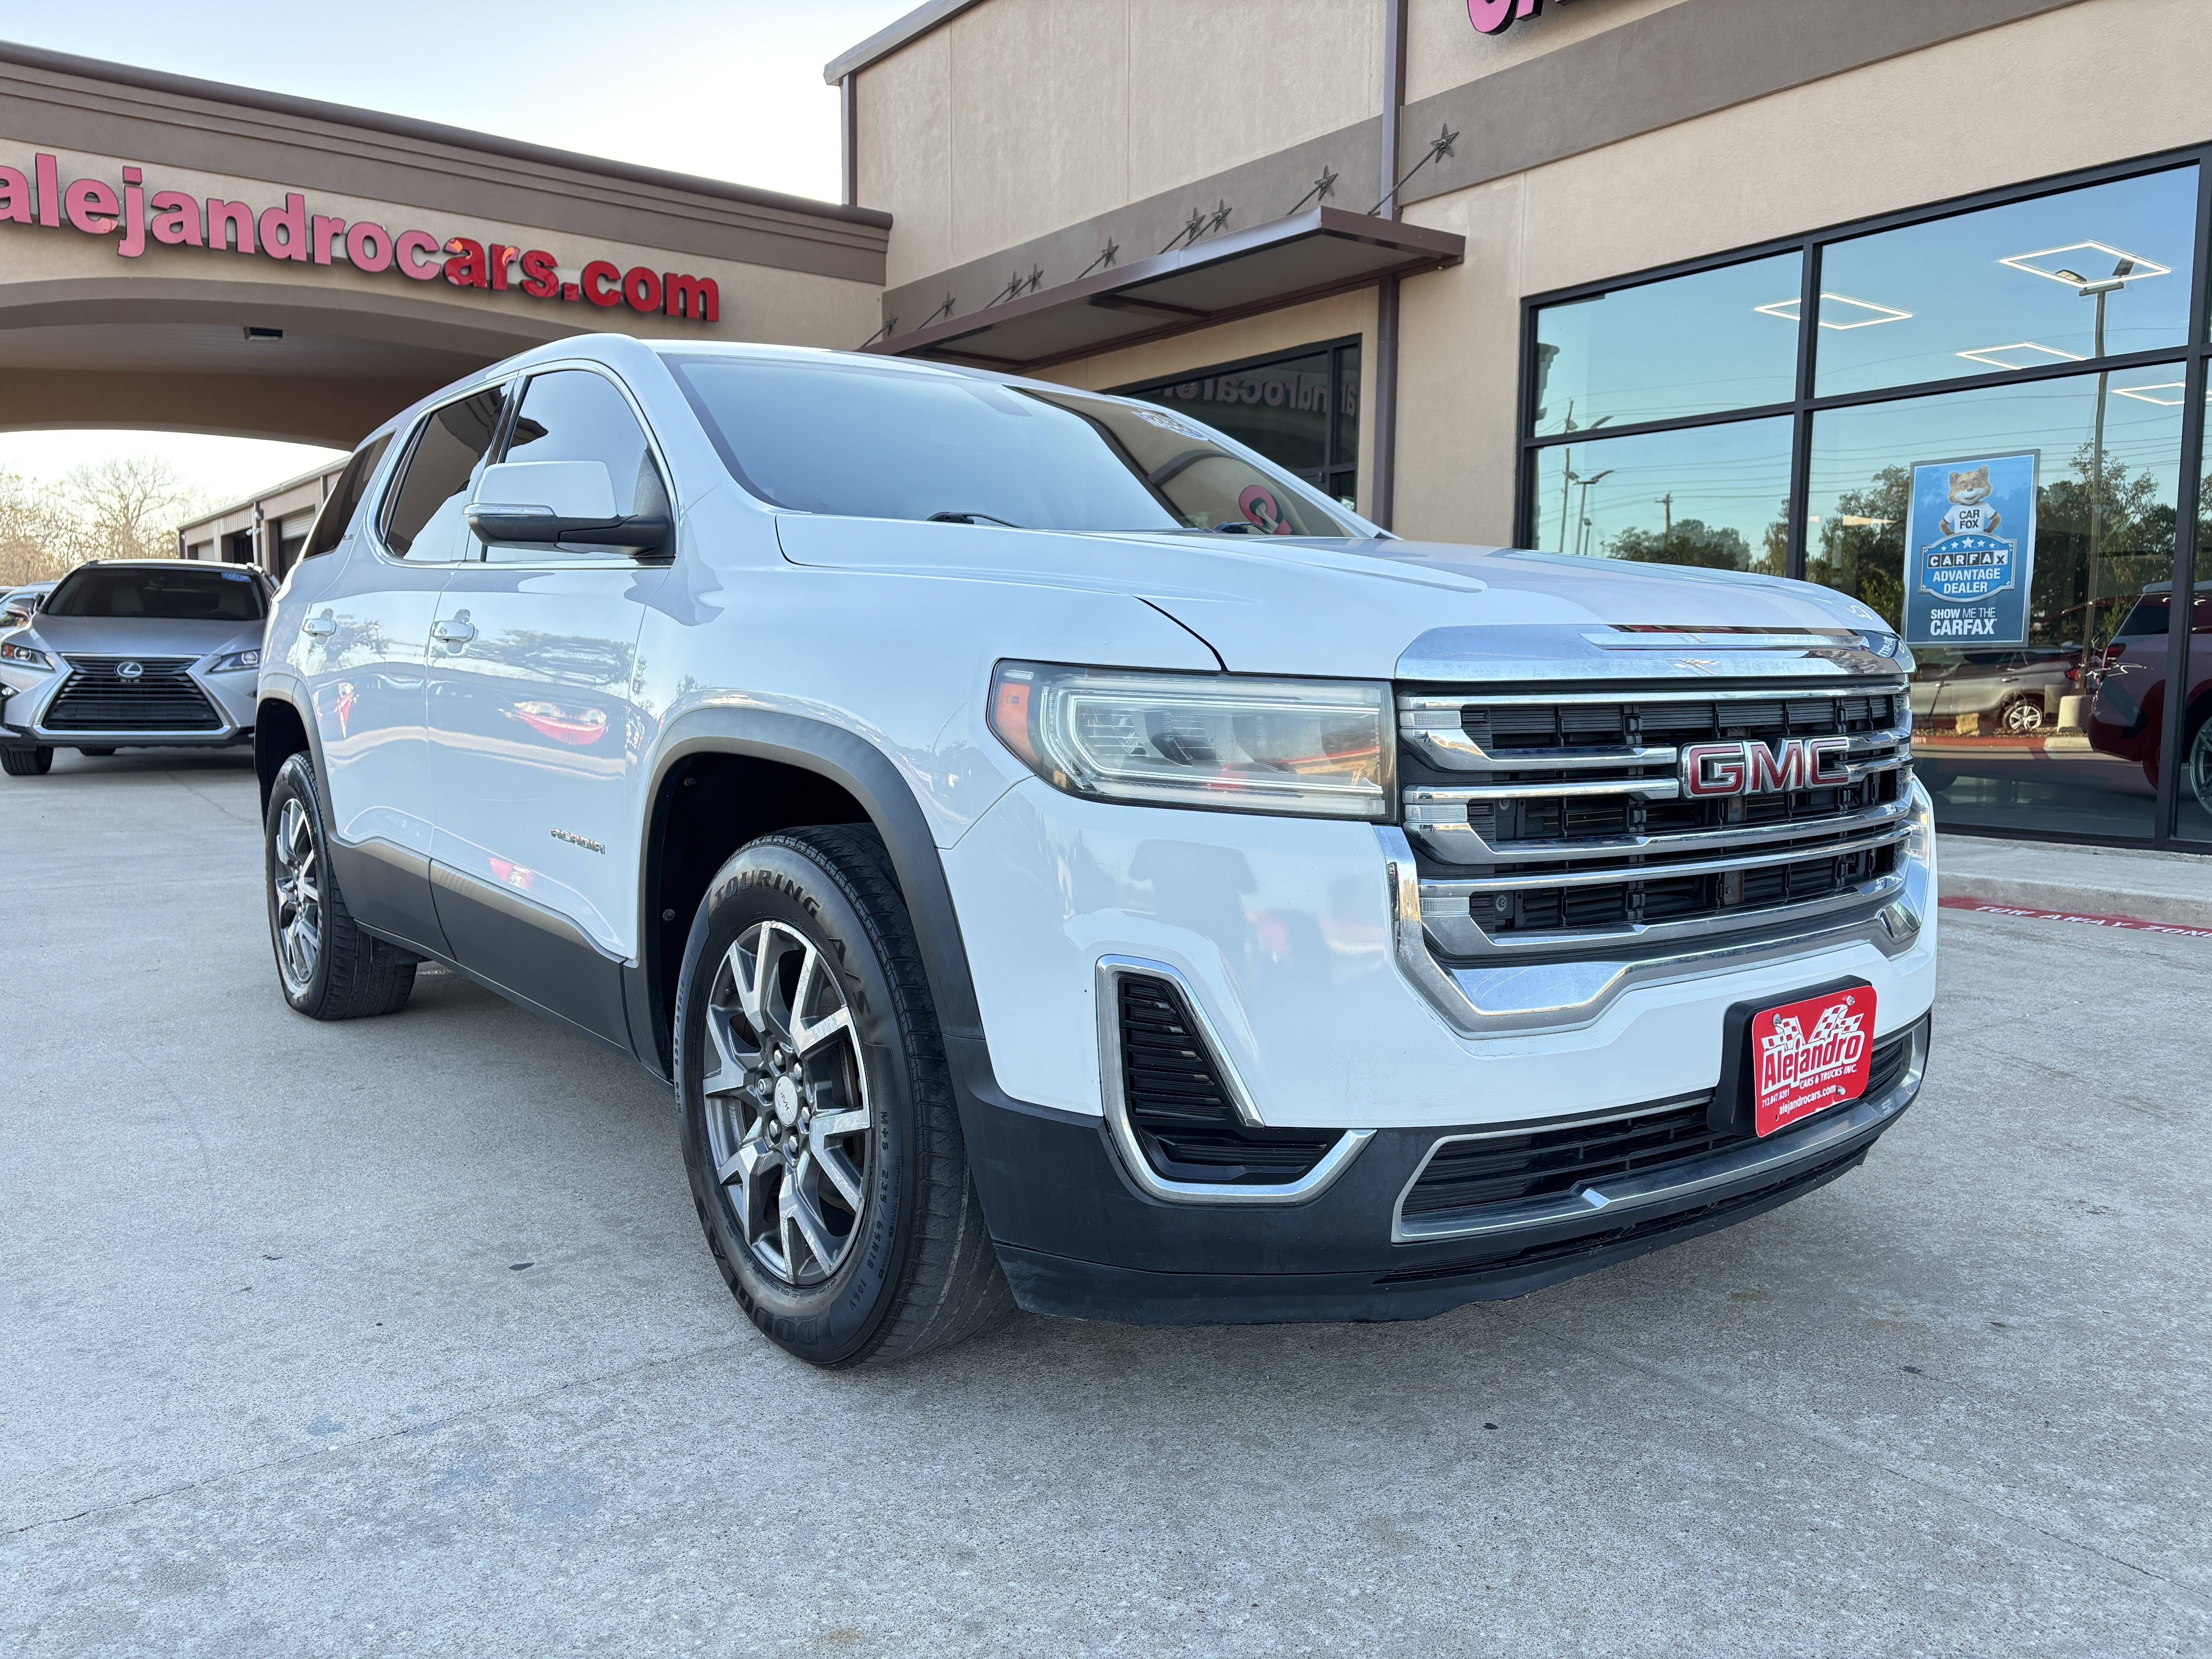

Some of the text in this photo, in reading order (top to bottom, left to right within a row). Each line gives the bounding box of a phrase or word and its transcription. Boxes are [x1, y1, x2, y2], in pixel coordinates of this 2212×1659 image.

[1959, 510, 1980, 520] CAR
[1960, 519, 1979, 529] FOX
[1929, 552, 2006, 567] CARFAX
[1933, 568, 2001, 582] ADVANTAGE
[1943, 582, 1988, 594] DEALER
[1930, 607, 1996, 619] SHOW ME THE
[1930, 618, 1996, 636] CARFAX
[1679, 736, 1850, 799] GMC
[550, 827, 605, 854] ACADIA
[715, 870, 821, 919] TOURING
[1761, 1027, 1865, 1096] Alejandro
[1800, 1064, 1857, 1089] CARS & TRUCKS INC.
[1779, 1084, 1836, 1115] alejandrocars.com
